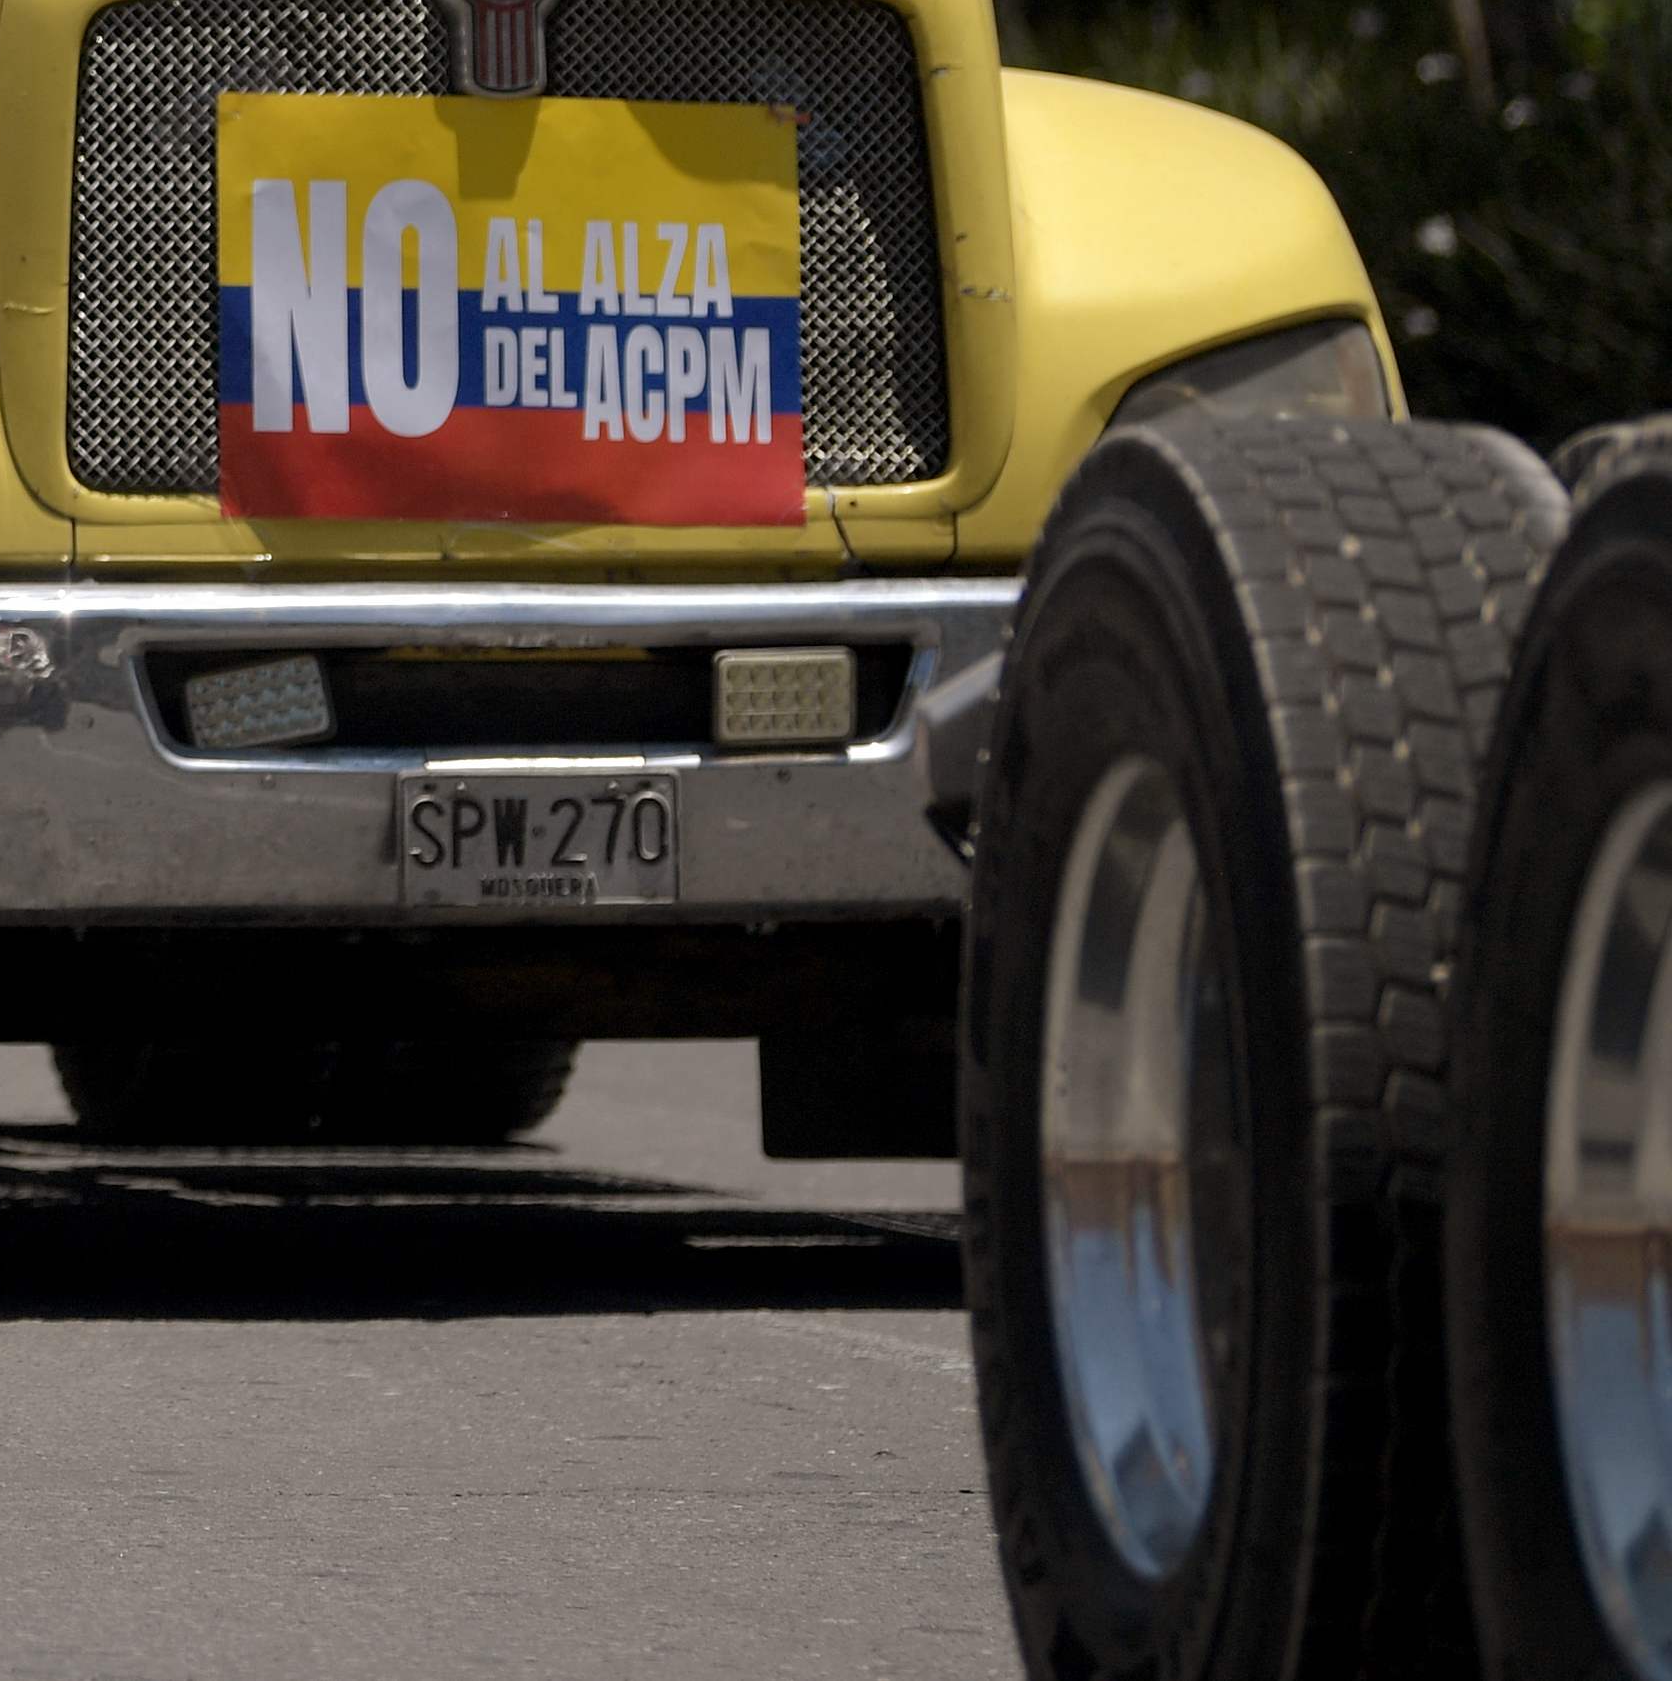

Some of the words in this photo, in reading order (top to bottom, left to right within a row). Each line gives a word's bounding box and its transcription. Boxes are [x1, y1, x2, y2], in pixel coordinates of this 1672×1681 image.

[251, 179, 459, 437] NO
[481, 217, 559, 313] AL
[579, 221, 734, 318] ALZA
[485, 327, 577, 409] DEL
[583, 324, 773, 444] ACPM
